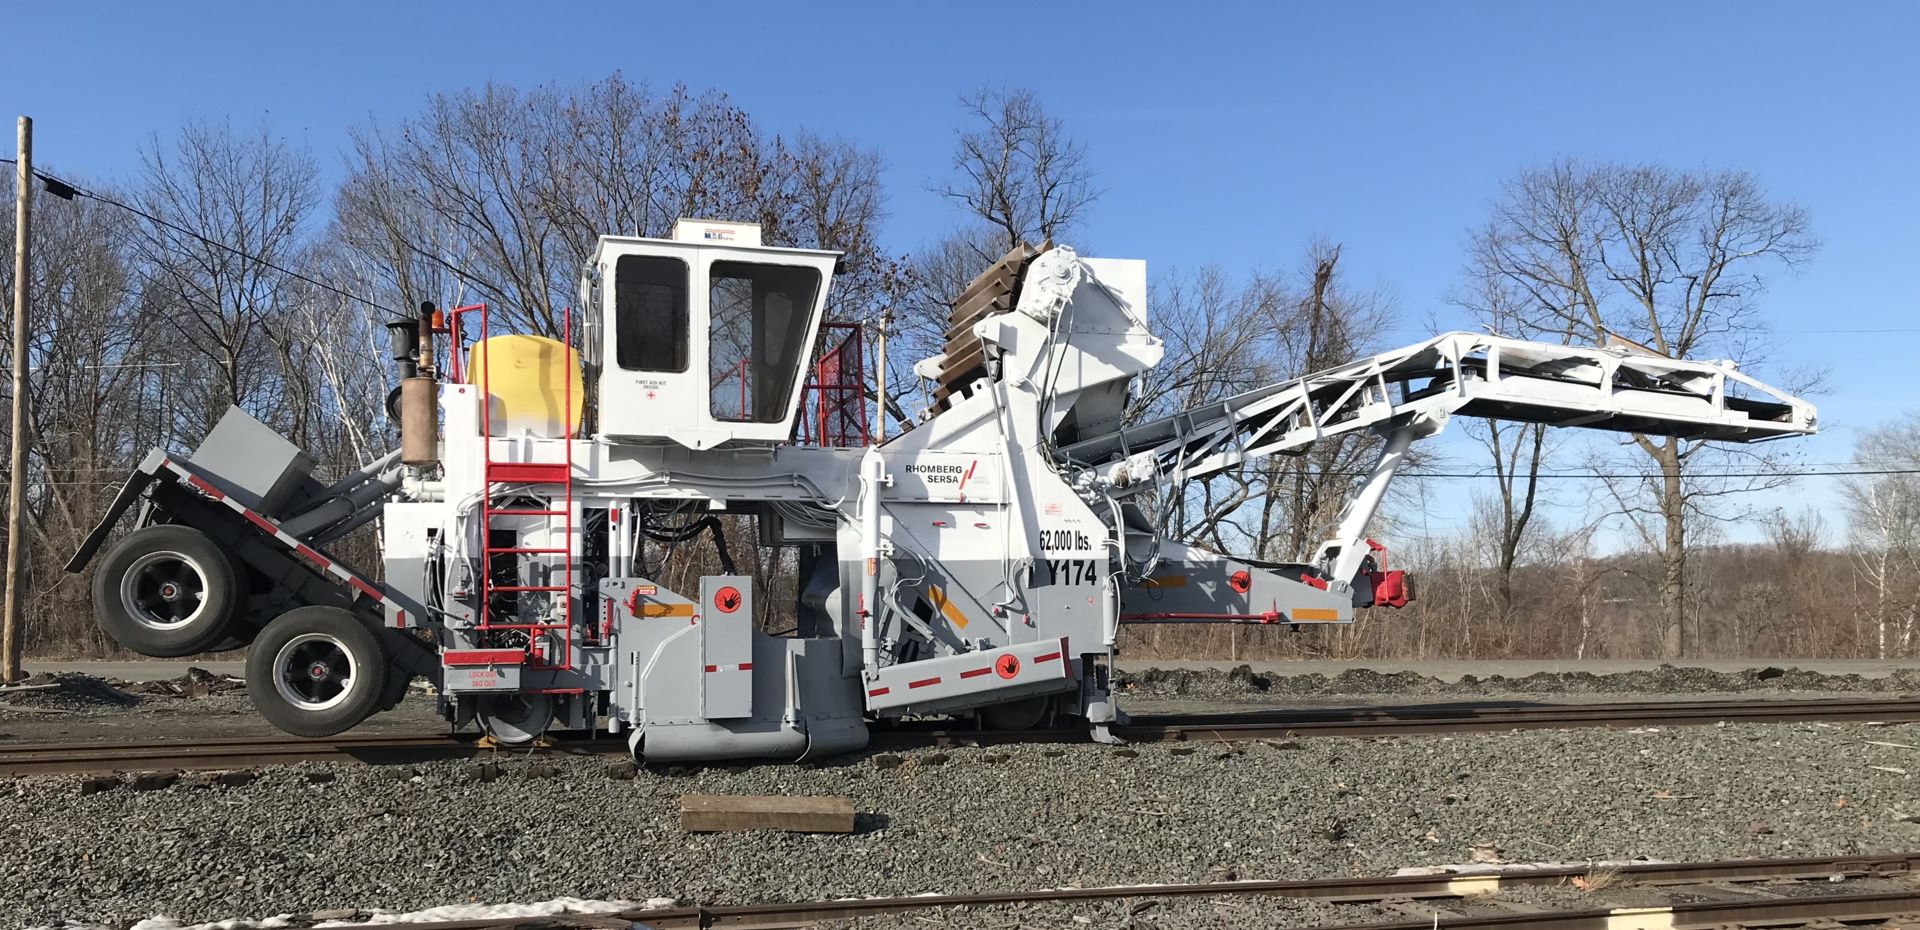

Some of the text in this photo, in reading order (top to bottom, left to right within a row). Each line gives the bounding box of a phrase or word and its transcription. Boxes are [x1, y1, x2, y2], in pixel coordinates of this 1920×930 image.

[905, 465, 963, 474] RHOMBERG
[927, 475, 959, 484] SERSA
[1040, 530, 1092, 555] 62,000 lbs.
[1046, 559, 1097, 586] Y174
